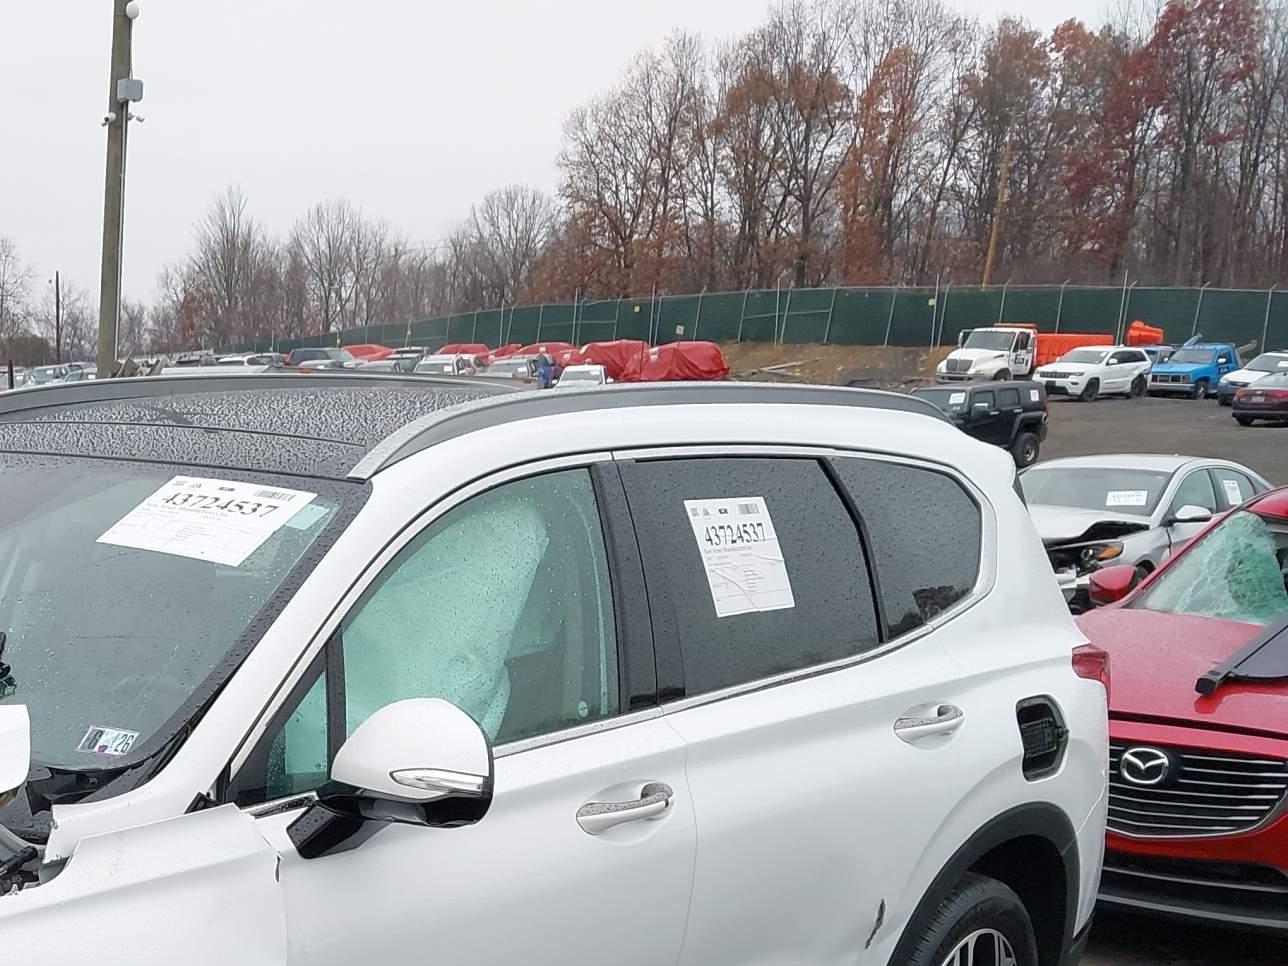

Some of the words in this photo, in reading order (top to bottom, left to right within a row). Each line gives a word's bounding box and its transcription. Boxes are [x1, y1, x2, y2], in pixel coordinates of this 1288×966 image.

[161, 492, 280, 518] 43724537
[704, 522, 766, 546] 43724537
[113, 733, 135, 753] 26
